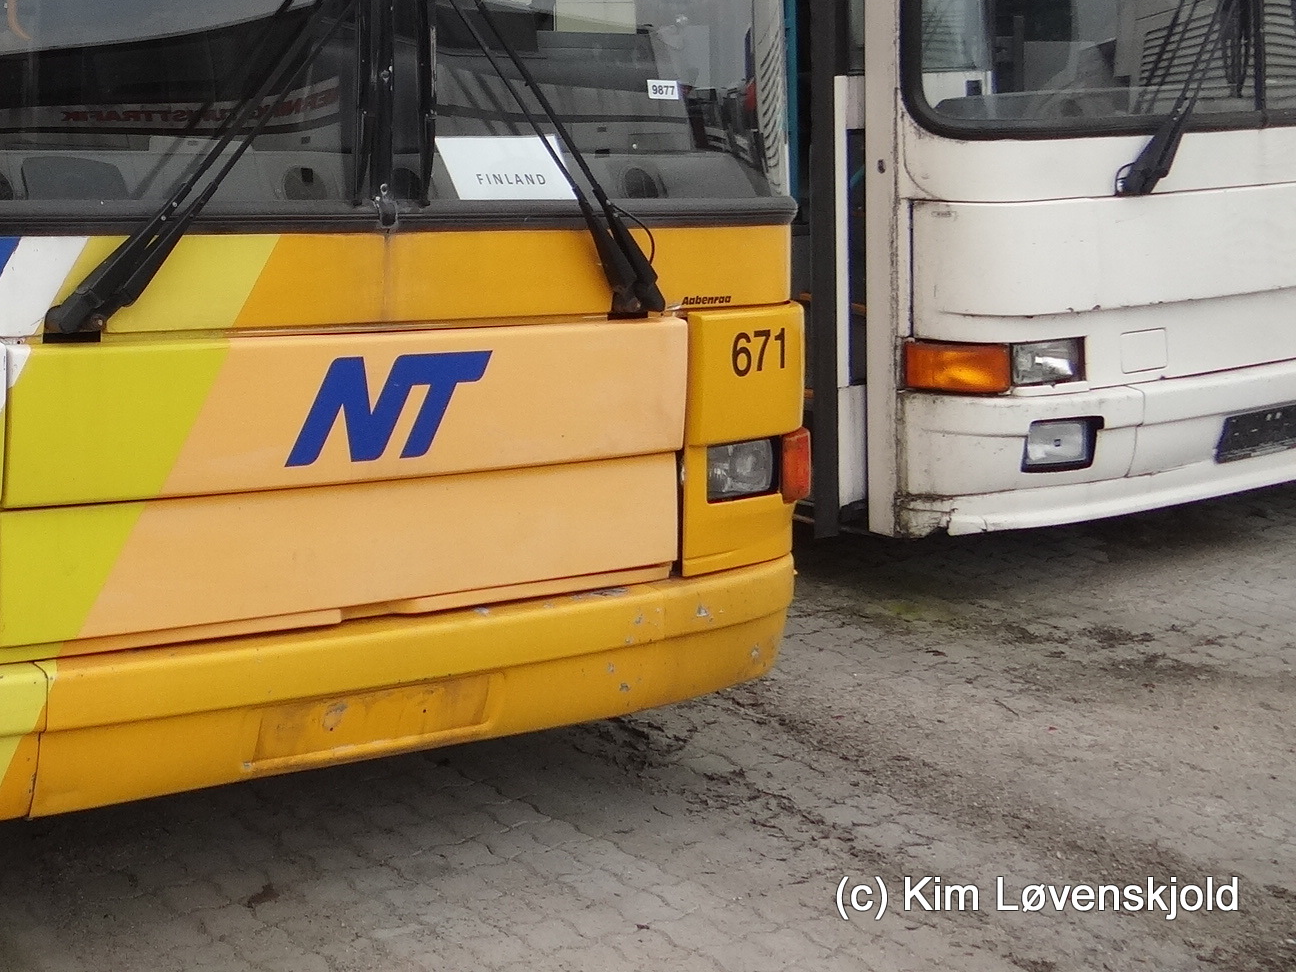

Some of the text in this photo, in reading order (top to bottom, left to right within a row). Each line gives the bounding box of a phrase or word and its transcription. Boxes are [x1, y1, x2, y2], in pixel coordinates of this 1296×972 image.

[651, 84, 675, 95] 9877
[476, 173, 546, 185] FINLAND
[681, 295, 732, 306] Aabenraa
[732, 327, 785, 377] 671
[284, 350, 493, 467] NT
